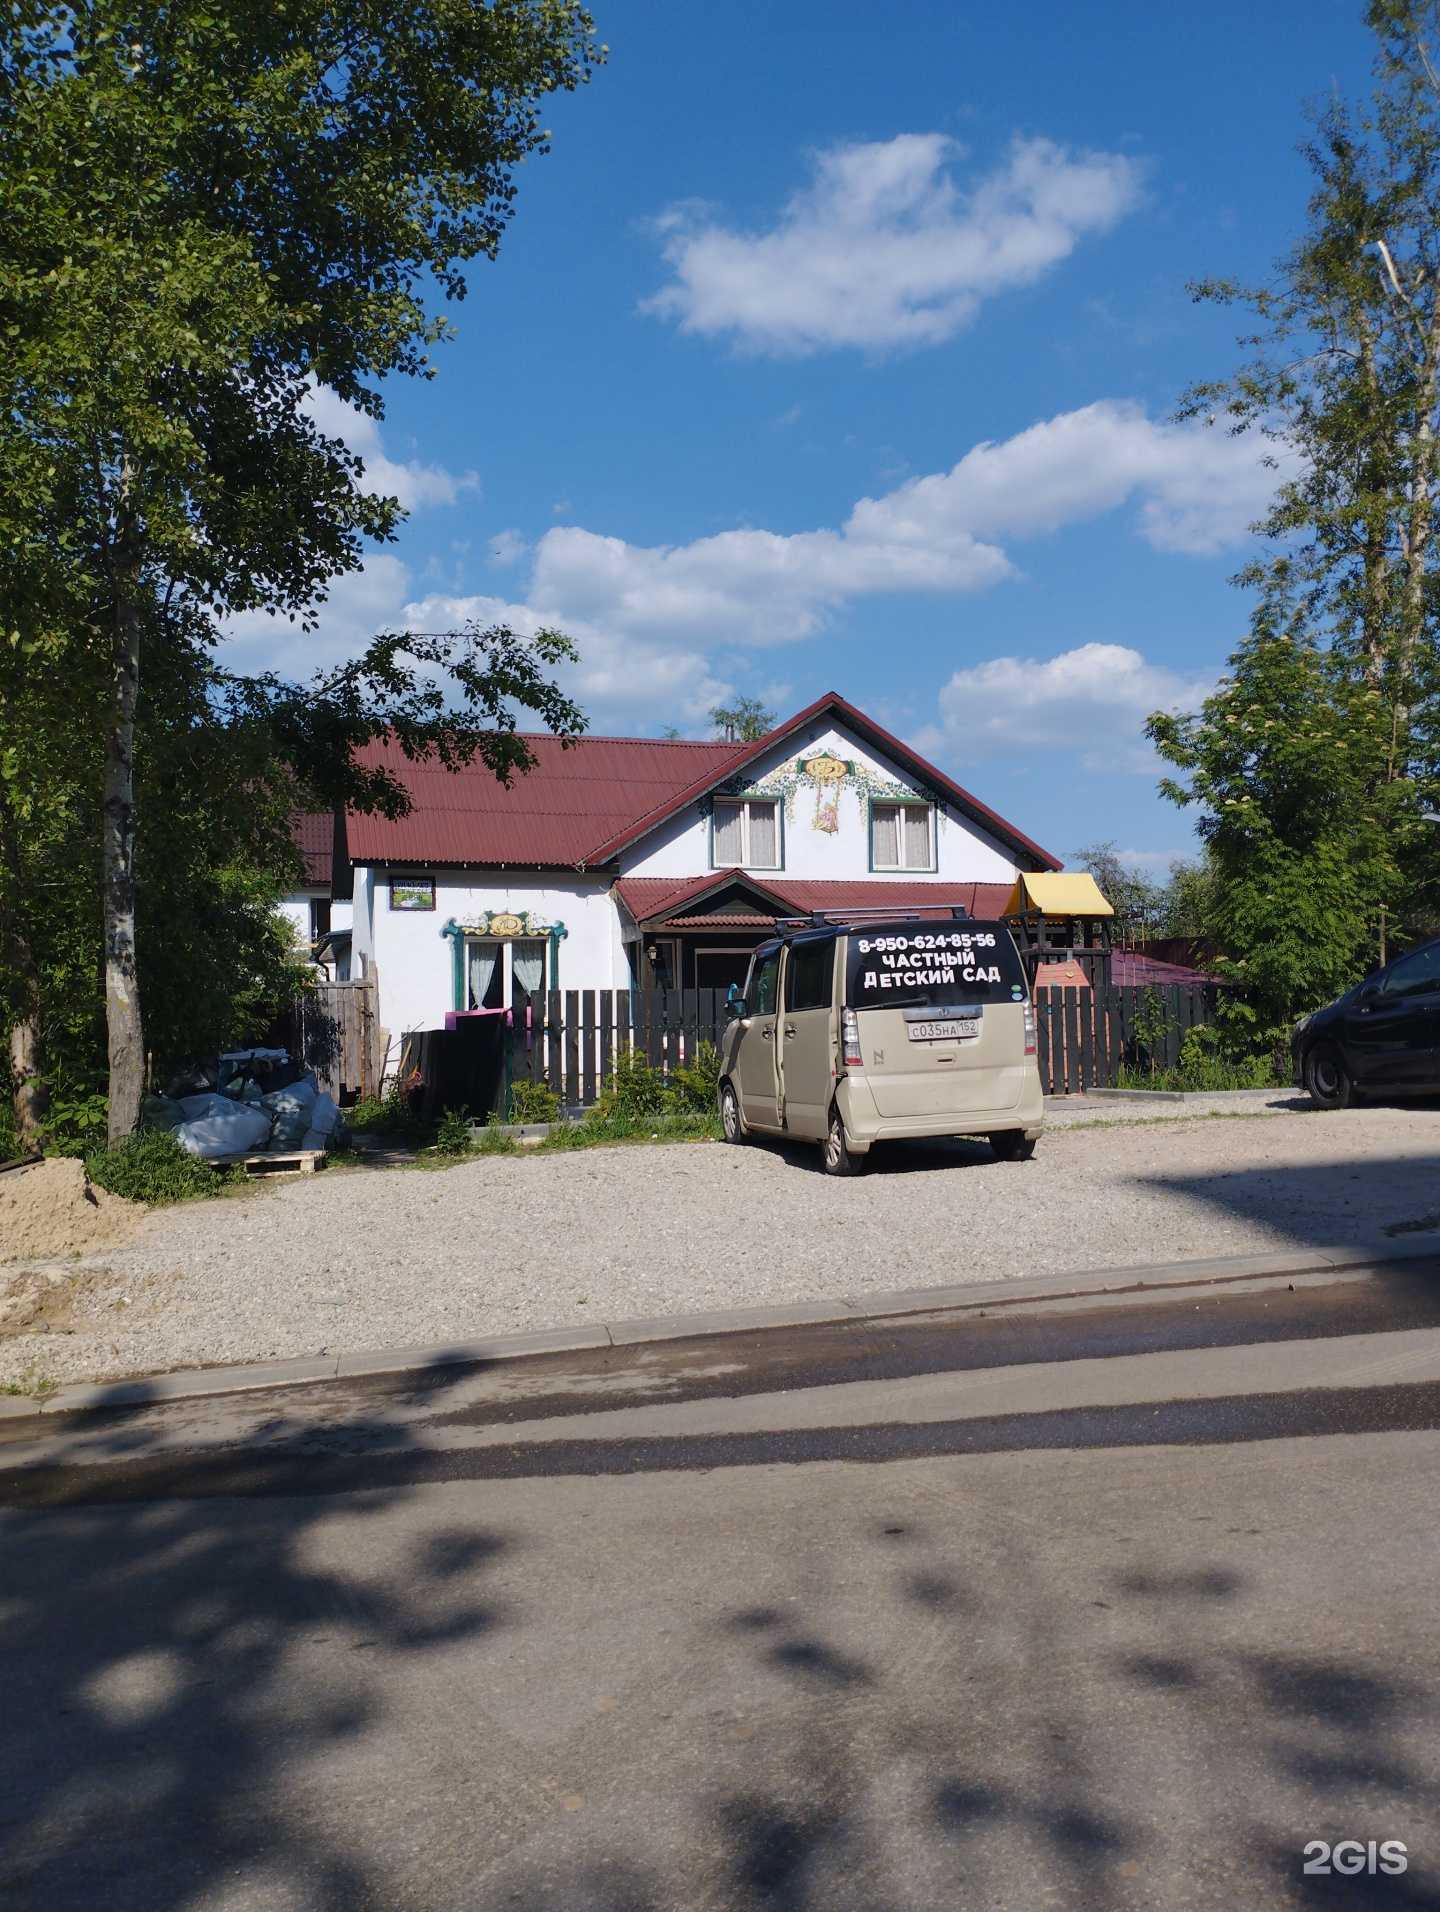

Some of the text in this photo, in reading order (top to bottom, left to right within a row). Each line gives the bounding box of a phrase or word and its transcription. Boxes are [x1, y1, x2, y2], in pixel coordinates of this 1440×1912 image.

[858, 934, 996, 953] 8-950-624-85-56
[881, 948, 976, 968] ЧАСТНЫЙ
[864, 966, 1001, 988] ДЕТСКИЙ САД
